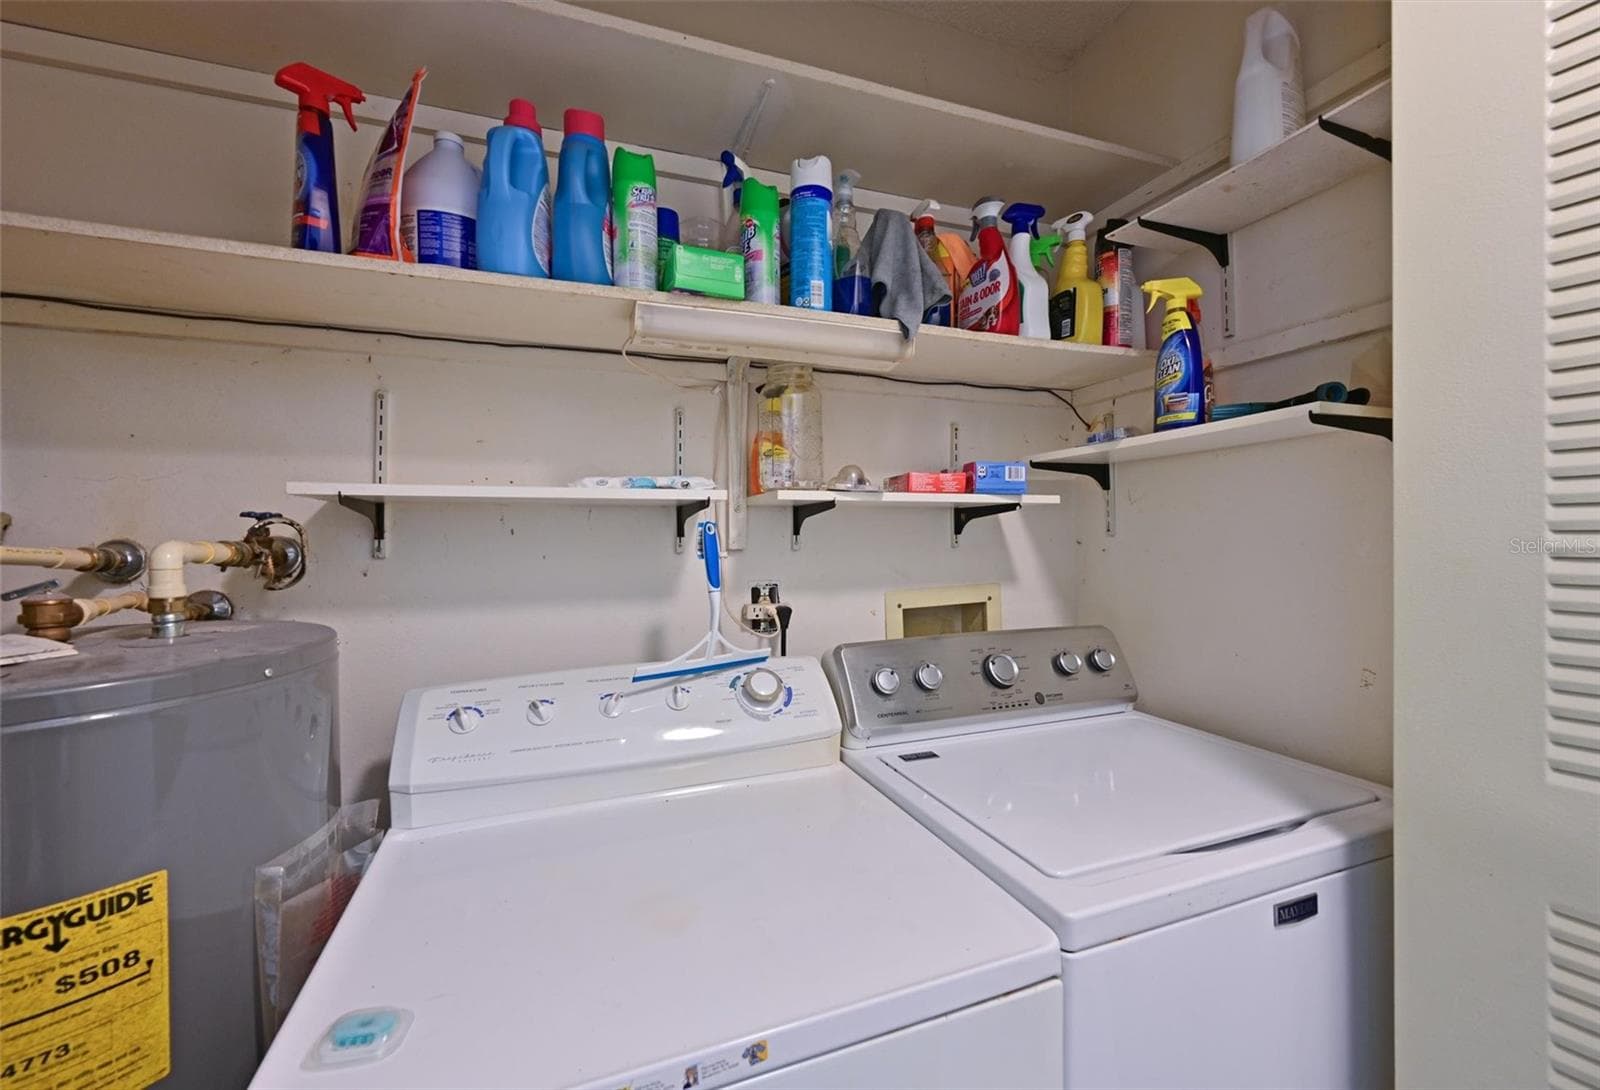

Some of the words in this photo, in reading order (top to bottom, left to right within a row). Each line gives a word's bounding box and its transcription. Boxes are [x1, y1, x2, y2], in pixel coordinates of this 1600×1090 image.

[980, 280, 1001, 300] ODOR
[55, 949, 141, 994] $508
[0, 1043, 70, 1079] 4773
